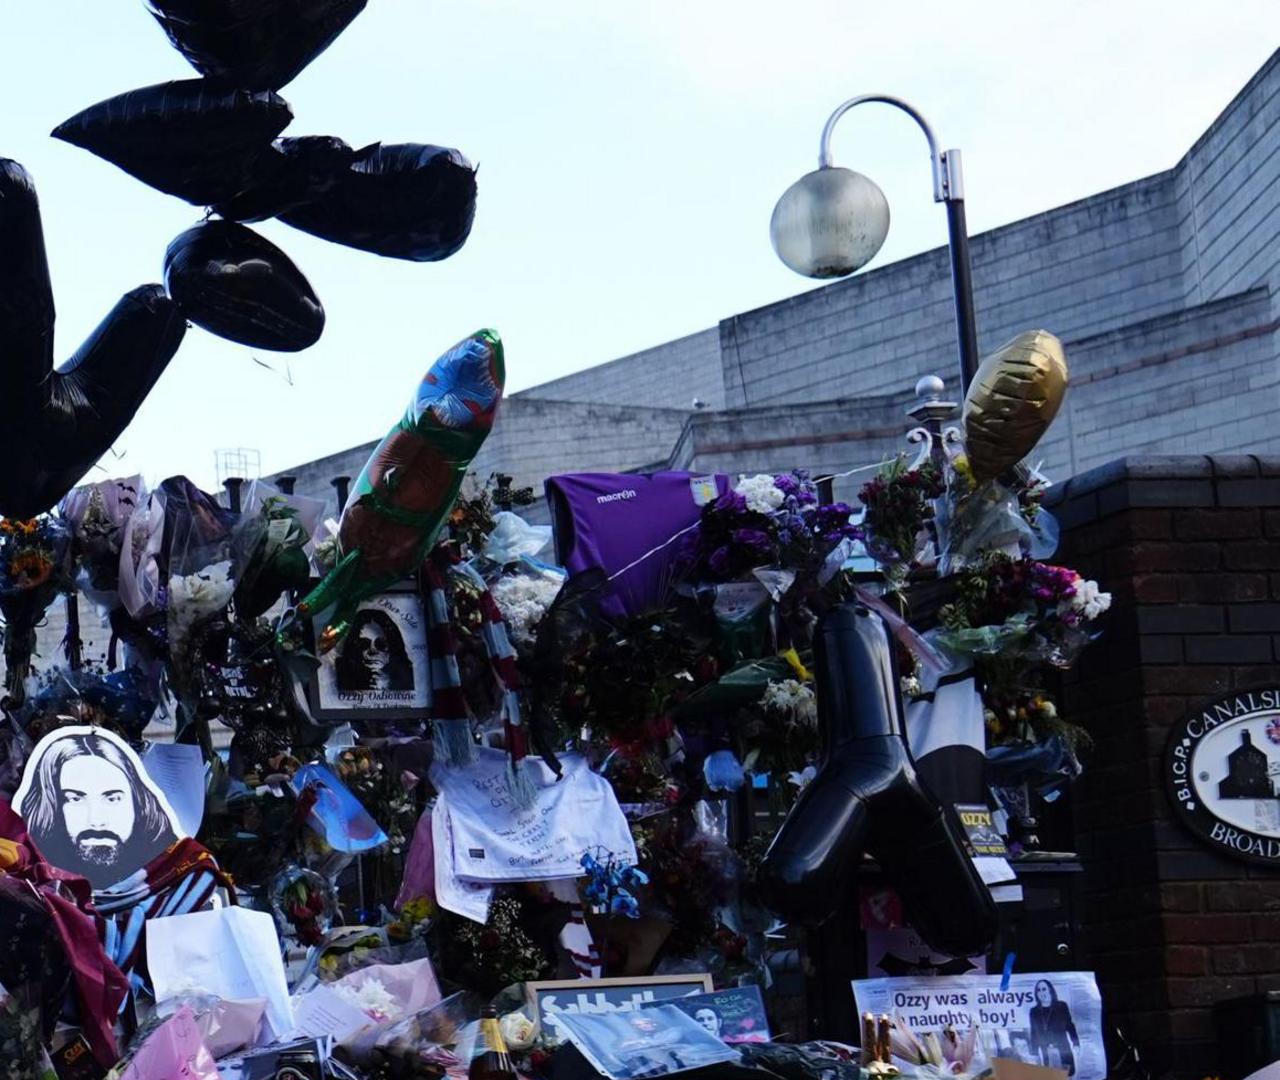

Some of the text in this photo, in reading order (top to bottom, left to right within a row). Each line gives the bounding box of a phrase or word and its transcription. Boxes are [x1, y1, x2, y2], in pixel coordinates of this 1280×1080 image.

[596, 489, 637, 504] macron
[1186, 690, 1280, 739] CANALSI
[960, 812, 992, 826] OZZY
[1210, 821, 1280, 858] BROAD
[895, 991, 931, 1010] Ozzy
[934, 993, 968, 1006] was
[977, 989, 1035, 1008] always
[909, 1008, 1016, 1027] naughty boy!
